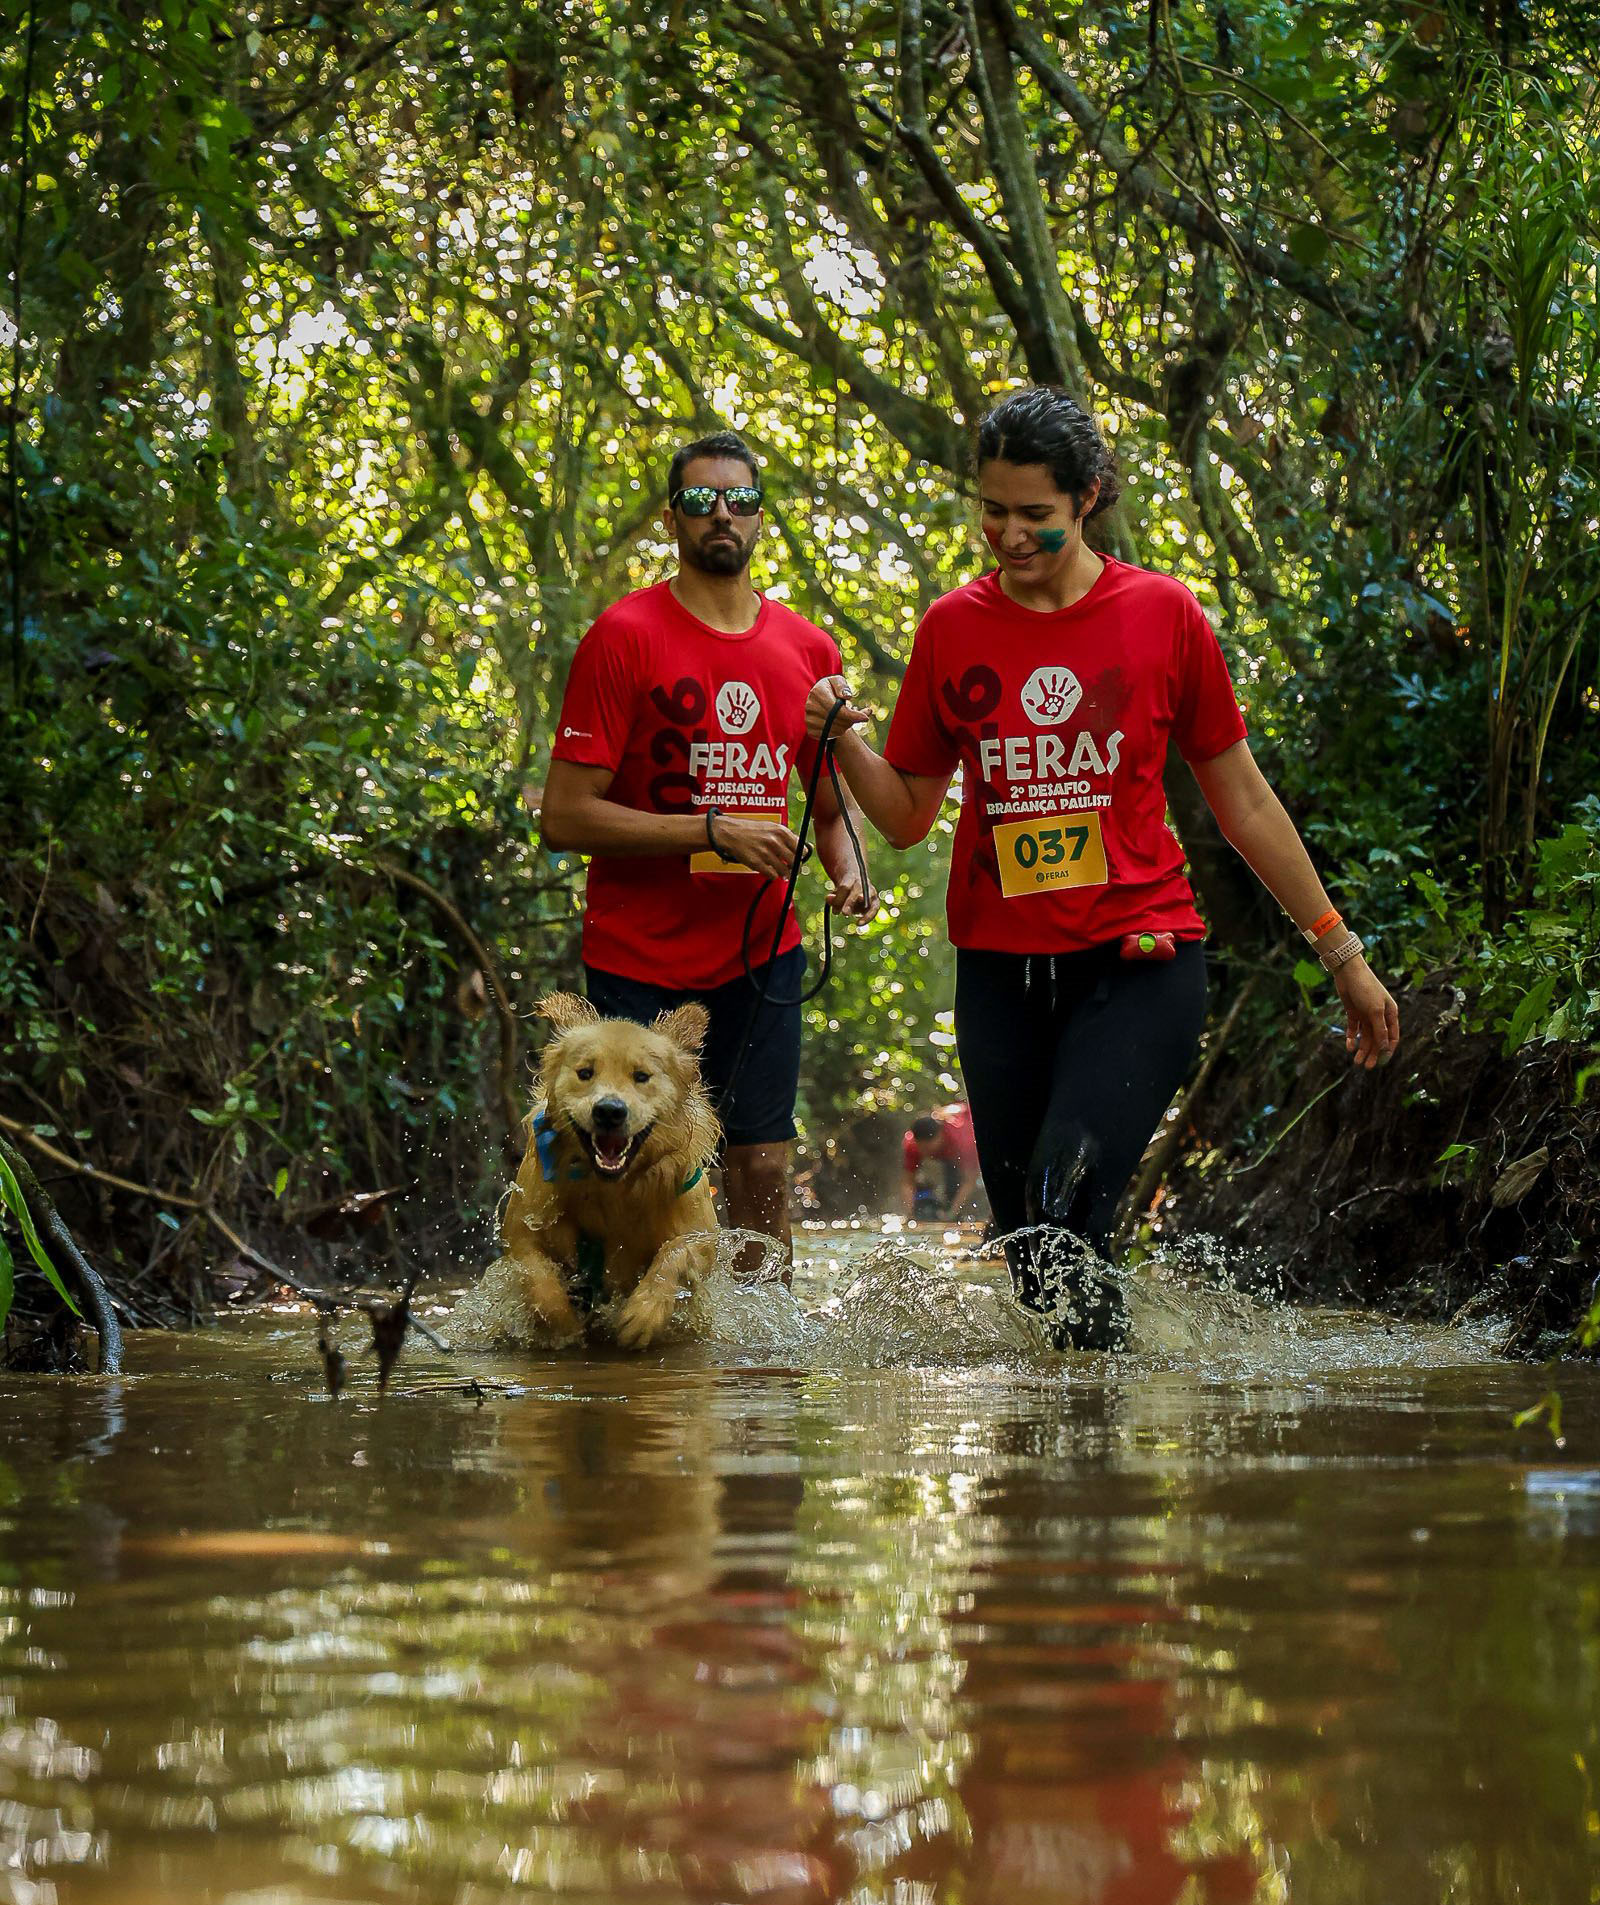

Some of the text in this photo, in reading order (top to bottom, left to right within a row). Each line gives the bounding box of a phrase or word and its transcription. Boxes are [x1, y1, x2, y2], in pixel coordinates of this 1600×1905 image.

[688, 742, 790, 782] FERAS
[980, 730, 1125, 782] FERAS
[718, 782, 766, 795] DESAFIO
[1028, 780, 1091, 798] DESAFIO
[986, 799, 1057, 816] BRAGANÇA
[1014, 825, 1090, 869] 037
[1045, 869, 1070, 881] FERAS
